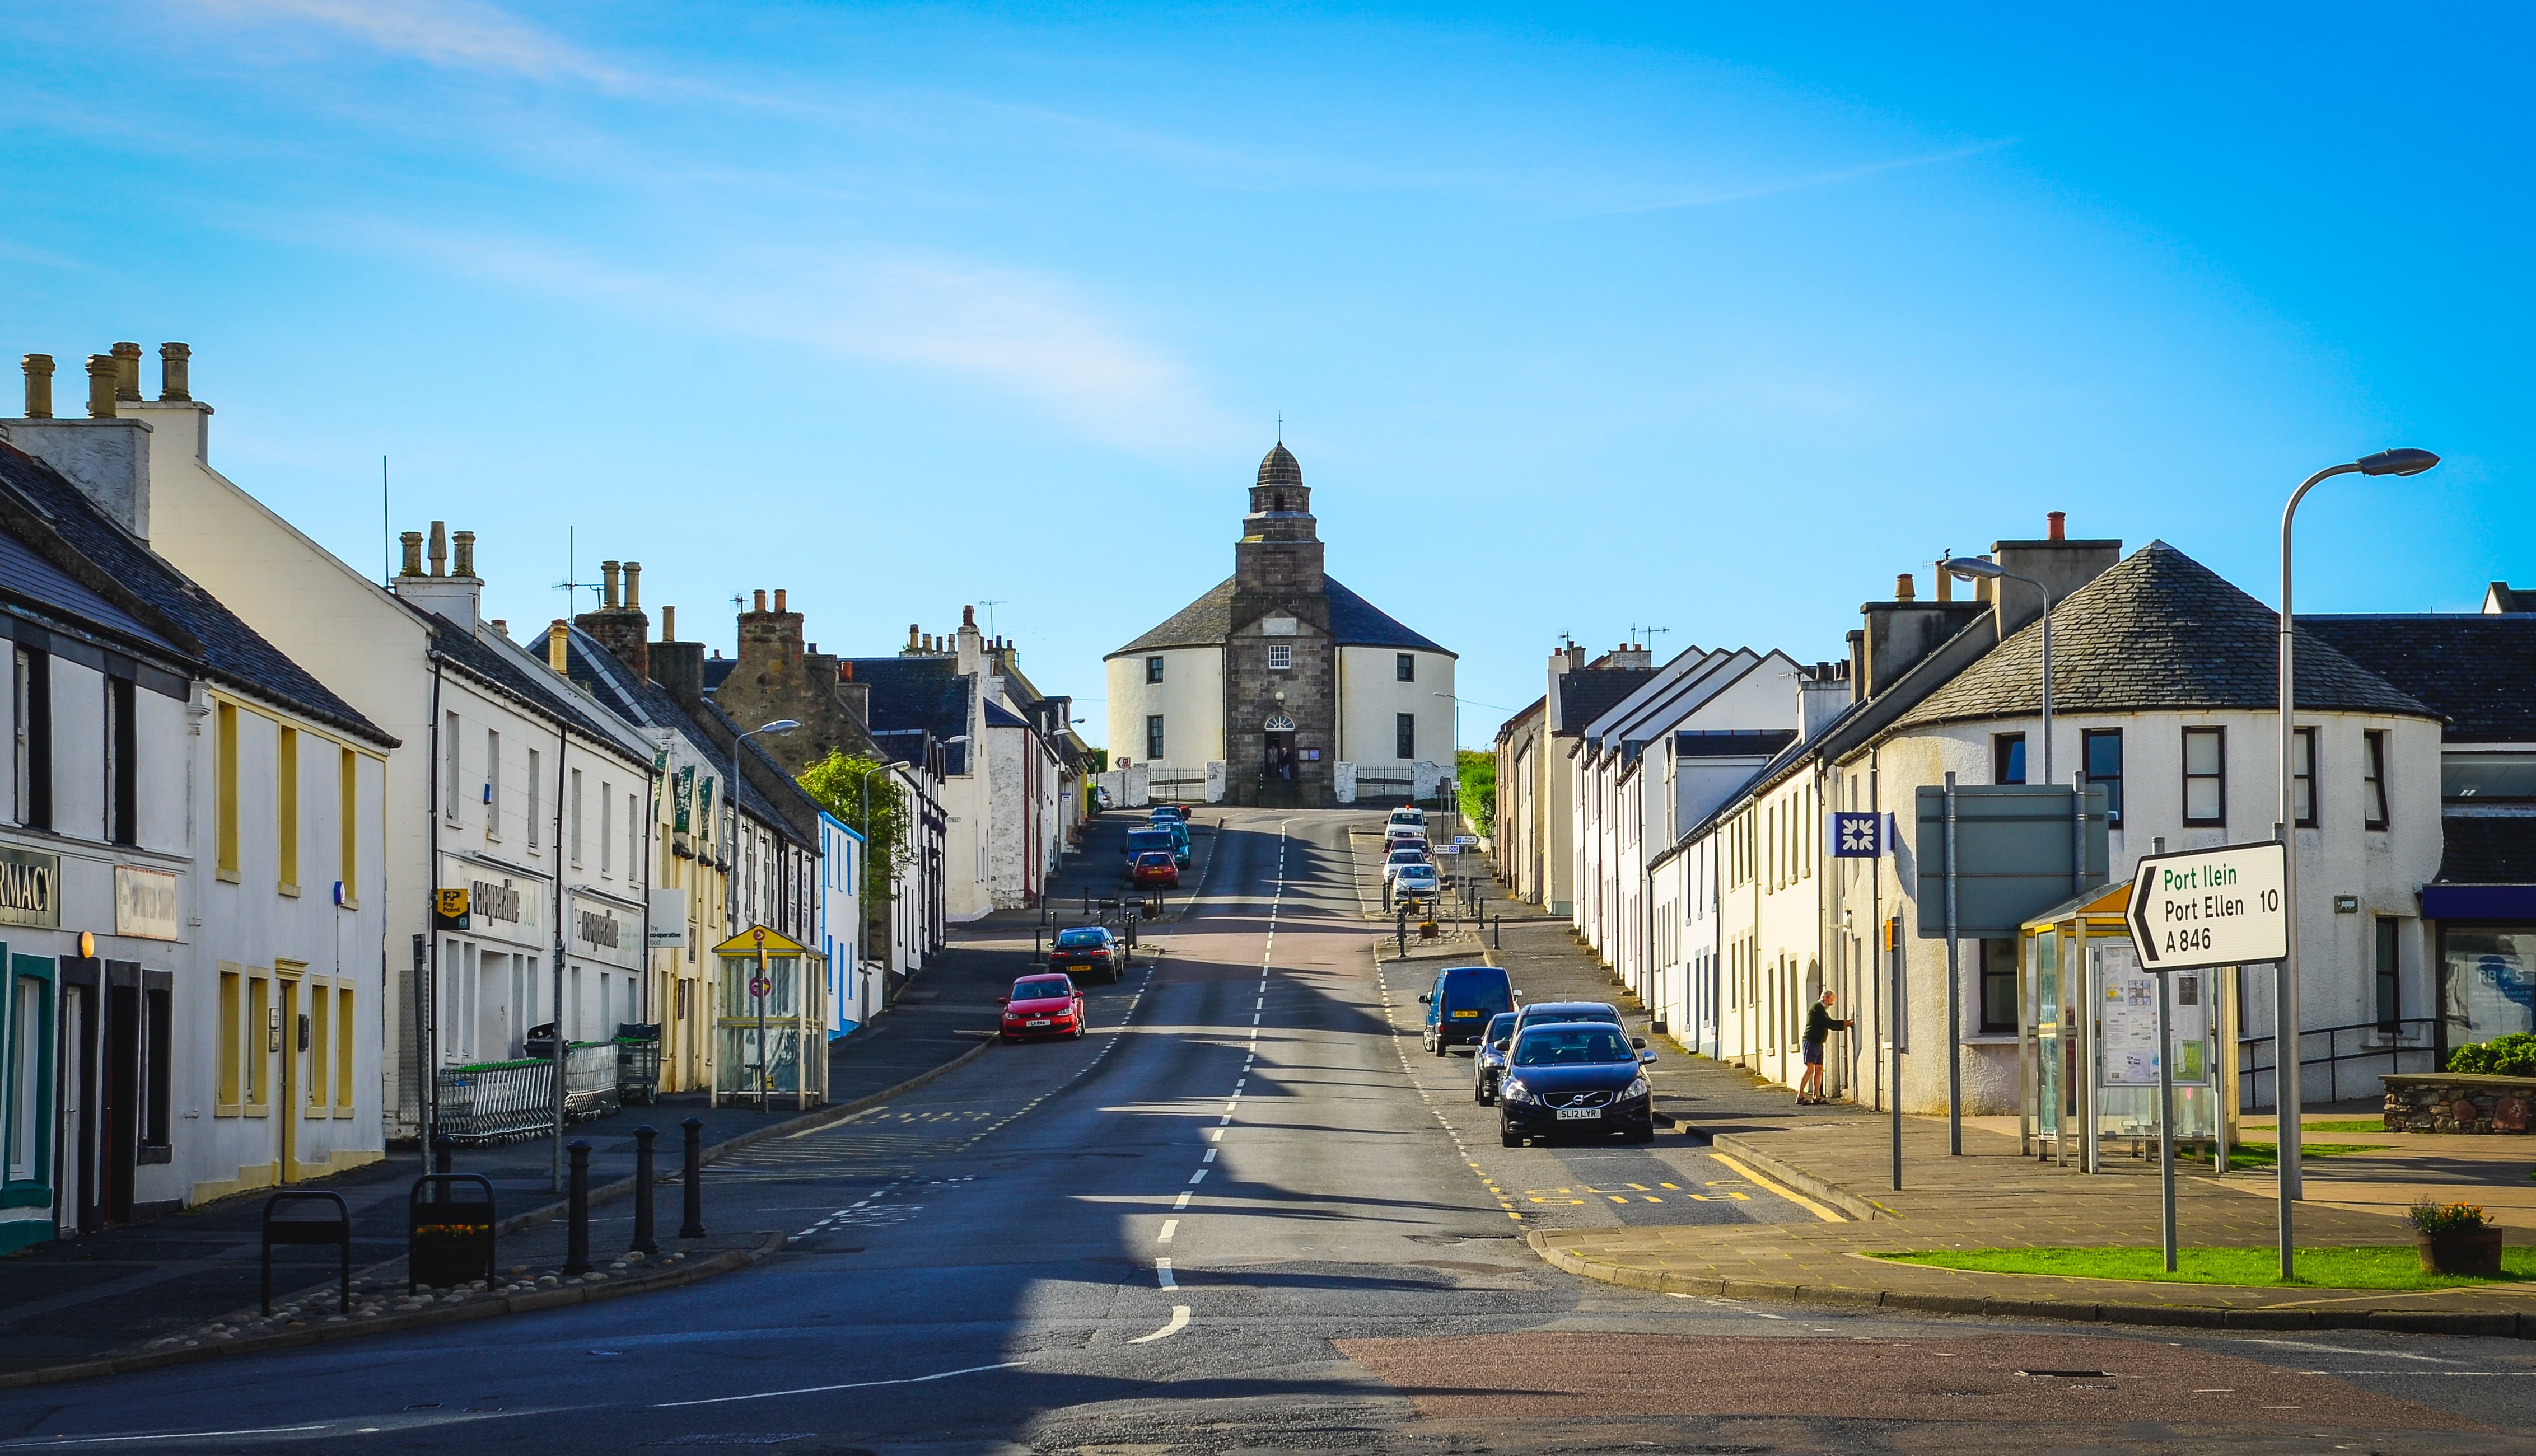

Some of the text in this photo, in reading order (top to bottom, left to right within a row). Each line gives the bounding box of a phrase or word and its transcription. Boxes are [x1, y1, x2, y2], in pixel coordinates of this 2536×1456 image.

[2164, 867, 2197, 891] Port
[474, 879, 520, 927] co-operative
[2165, 889, 2278, 922] Port Ellen 10
[582, 909, 619, 952] co-operative
